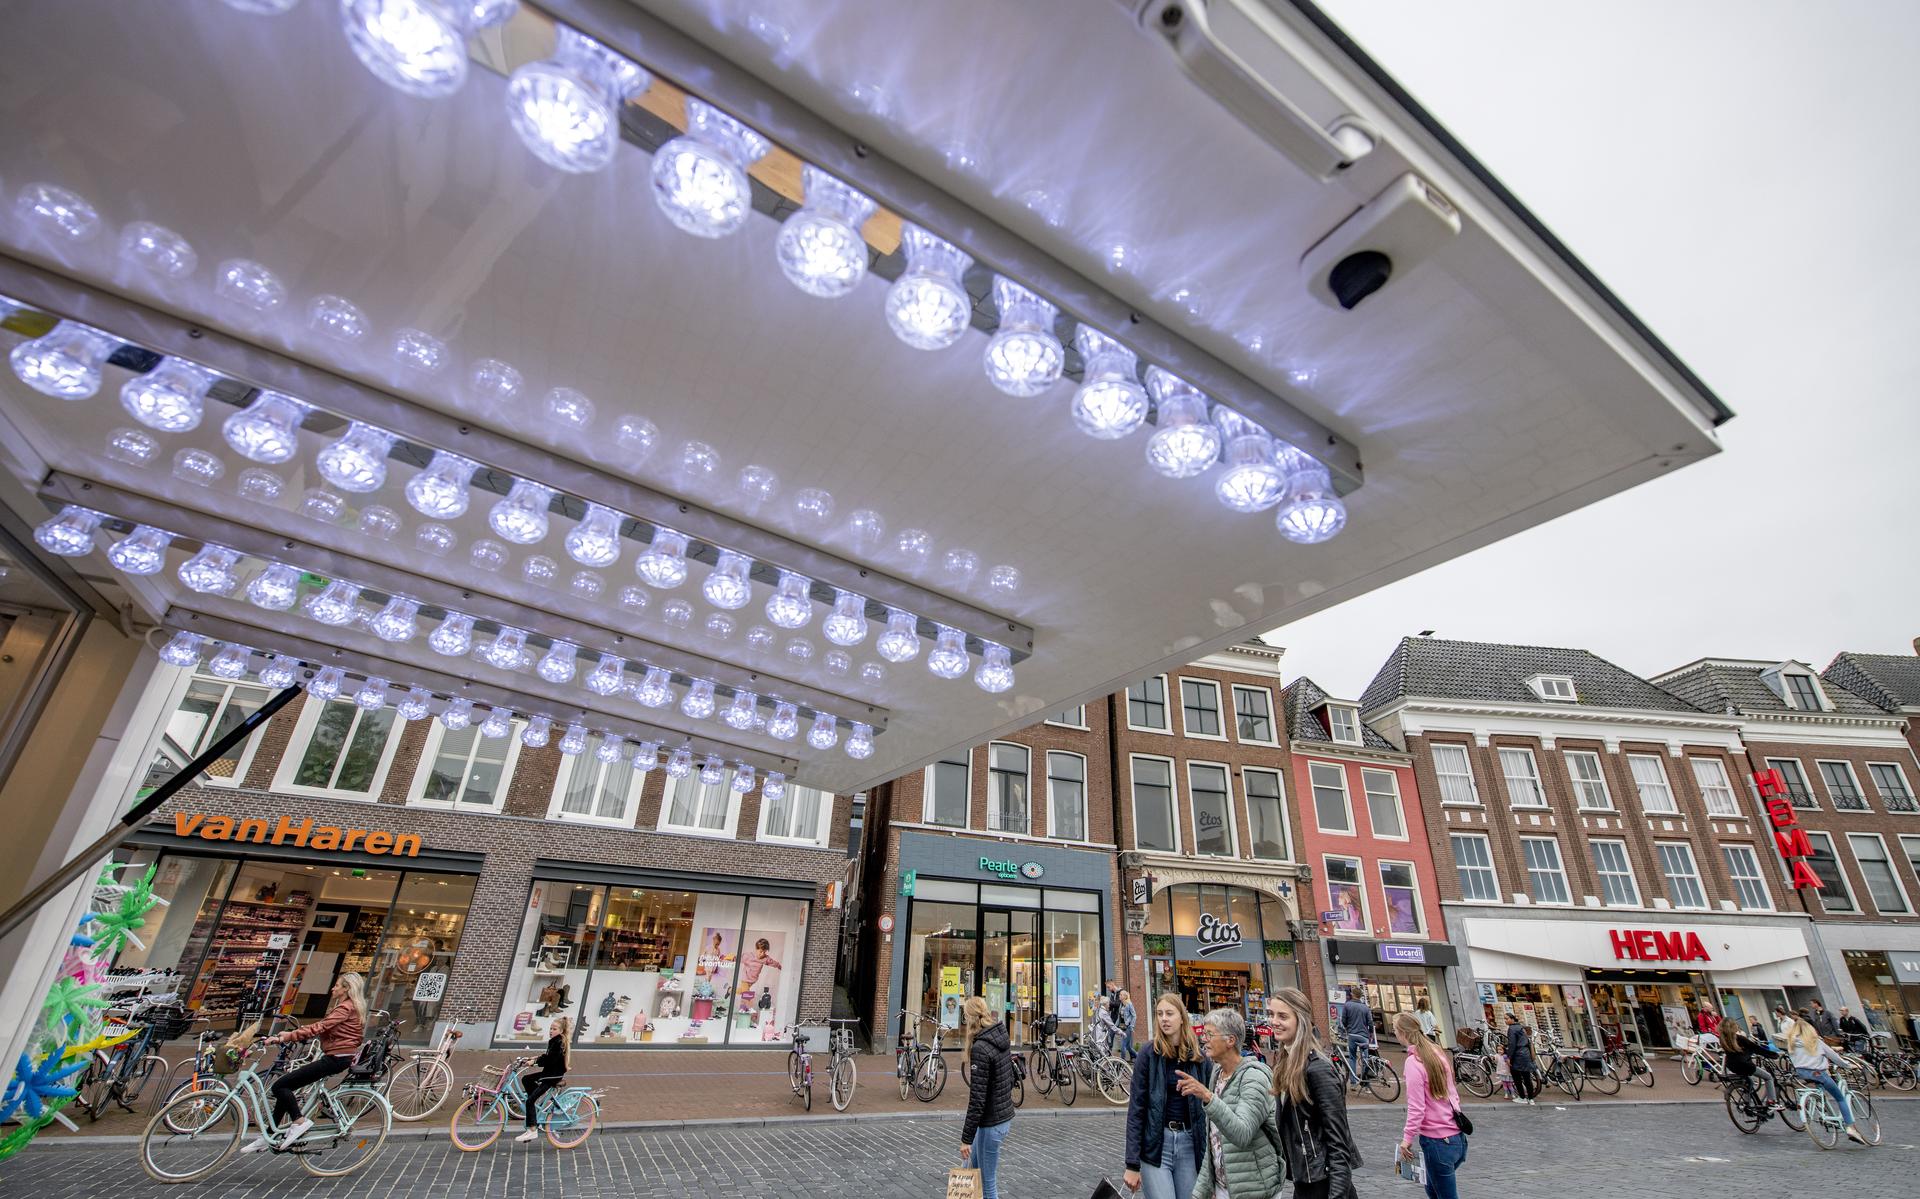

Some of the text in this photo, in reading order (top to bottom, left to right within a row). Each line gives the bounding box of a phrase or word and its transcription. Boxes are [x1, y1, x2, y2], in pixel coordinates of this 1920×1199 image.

[1200, 811, 1222, 826] Etos
[175, 811, 422, 857] vanHaren
[1754, 768, 1825, 889] HEMA
[980, 857, 1017, 873] Pearle
[1134, 881, 1146, 895] Etos
[1198, 914, 1240, 944] Etos
[1395, 948, 1422, 957] Lucardi
[1609, 930, 1711, 961] HEMA
[1901, 961, 1920, 971] VI
